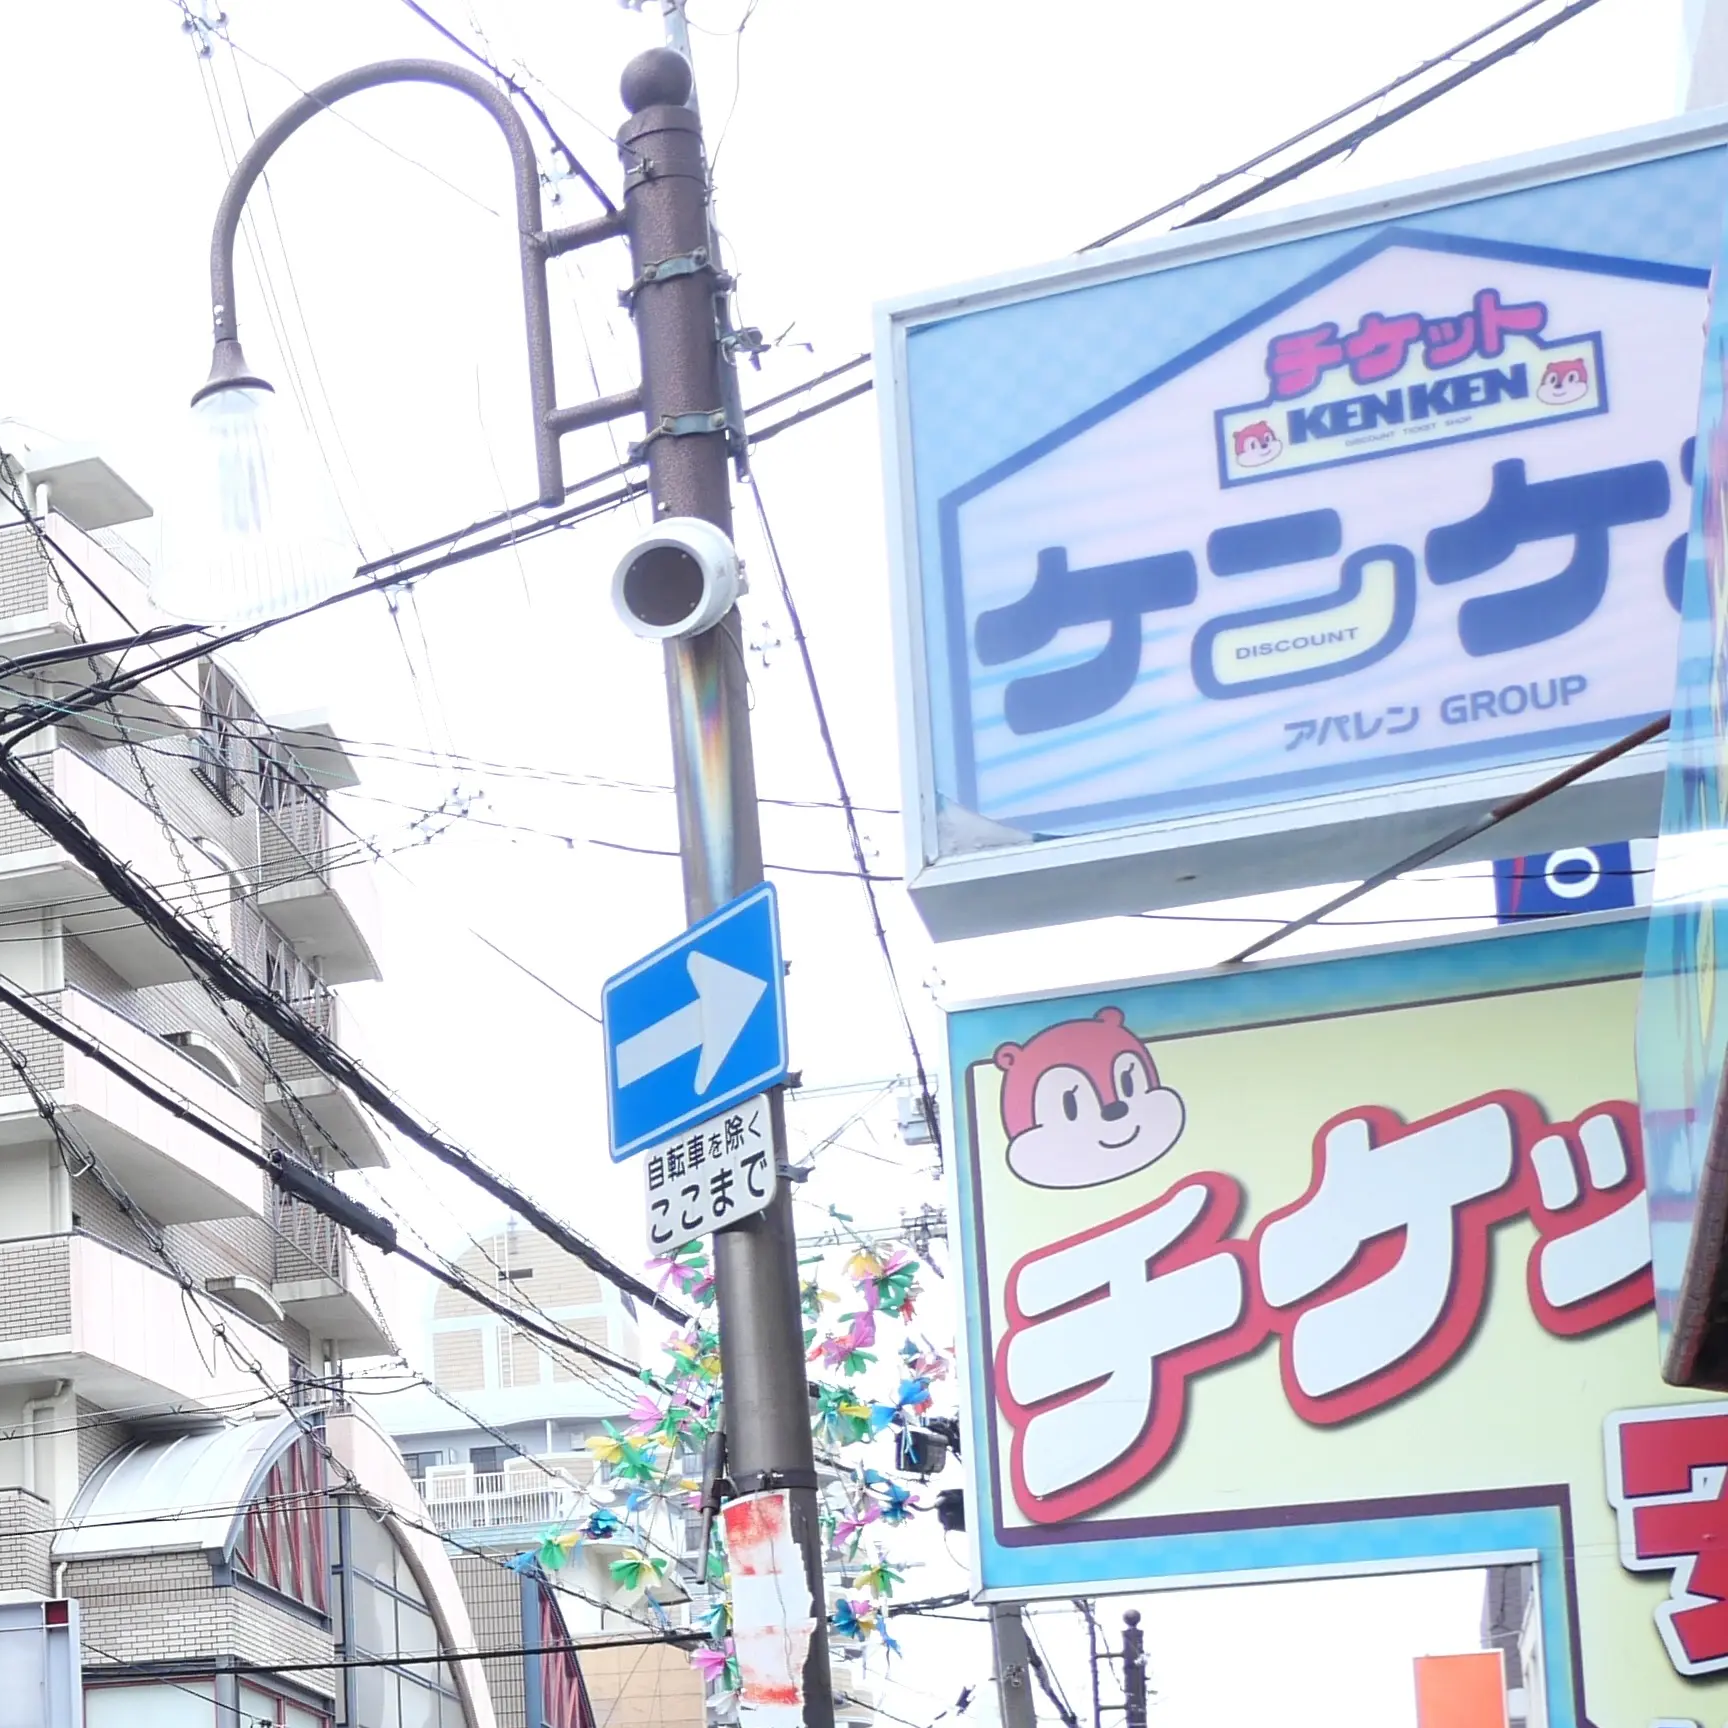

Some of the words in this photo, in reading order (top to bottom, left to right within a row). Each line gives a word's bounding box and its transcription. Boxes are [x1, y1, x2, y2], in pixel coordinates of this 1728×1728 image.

[1271, 288, 1547, 398] チケット
[1234, 625, 1360, 661] DISCOUNT
[1440, 674, 1589, 727] GROUP
[648, 1109, 762, 1193] 自転車を除く
[650, 1150, 768, 1244] ここまで
